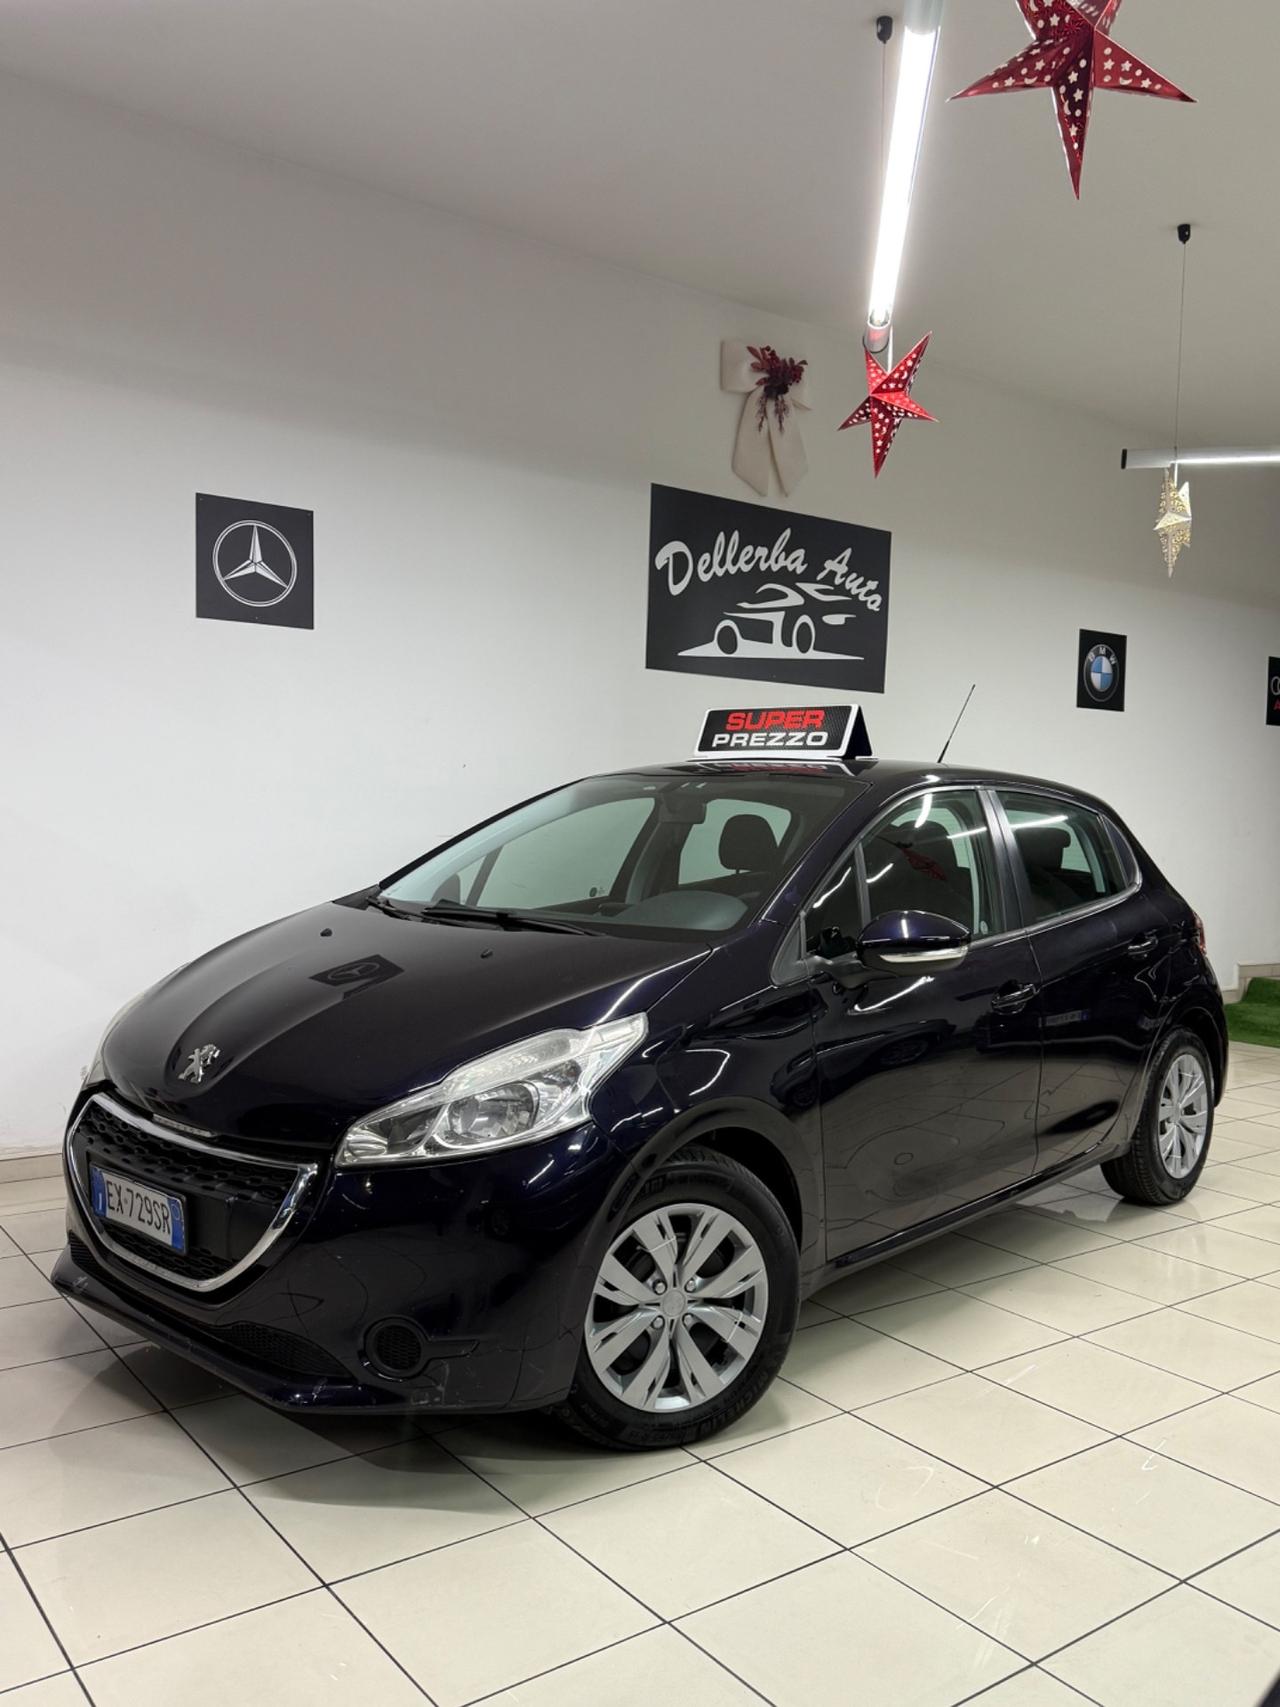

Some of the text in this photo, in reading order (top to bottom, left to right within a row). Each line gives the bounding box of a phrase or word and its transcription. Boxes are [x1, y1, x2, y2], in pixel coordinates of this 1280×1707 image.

[655, 528, 883, 612] Dellerba Auto
[1088, 646, 1117, 665] BMW
[725, 710, 825, 731] SUPER
[711, 732, 828, 747] PREZZO
